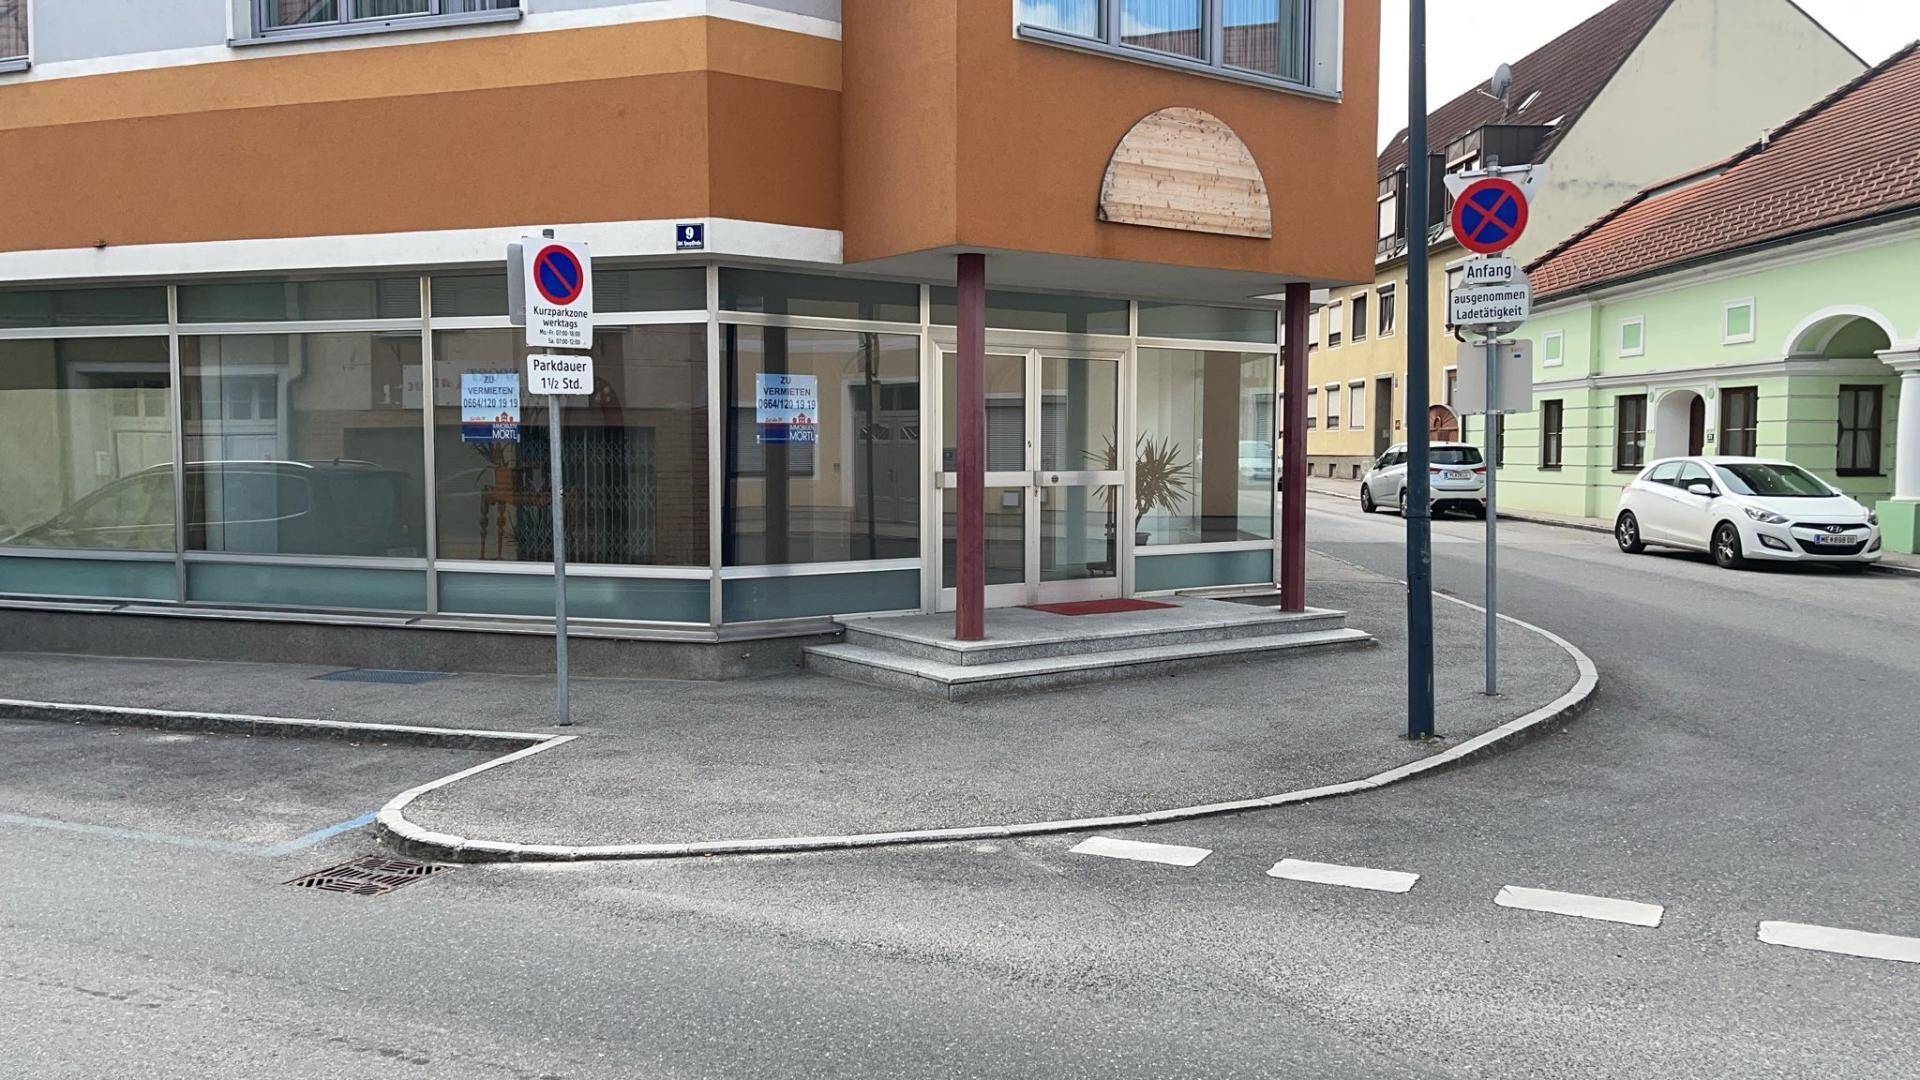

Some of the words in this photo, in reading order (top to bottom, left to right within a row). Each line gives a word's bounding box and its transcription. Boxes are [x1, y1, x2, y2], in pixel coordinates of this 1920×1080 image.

[685, 226, 695, 240] 9
[1466, 265, 1512, 279] Anfang
[1454, 290, 1525, 305] ausgenommen
[533, 305, 588, 319] Kurzparkzone
[1456, 305, 1523, 320] Ladetätigkeit
[543, 318, 578, 328] werktags
[533, 359, 587, 372] Parkdauer
[483, 376, 494, 384] ZU
[562, 377, 583, 390] Std.
[780, 376, 791, 384] ZU
[467, 387, 513, 395] VERMIETEN
[763, 387, 811, 396] VERMIETEN
[463, 398, 496, 408] 0664/120
[499, 398, 507, 408] 19
[510, 398, 518, 408] 19
[759, 399, 793, 410] 0664/120
[796, 400, 804, 410] 19
[807, 400, 816, 410] 19
